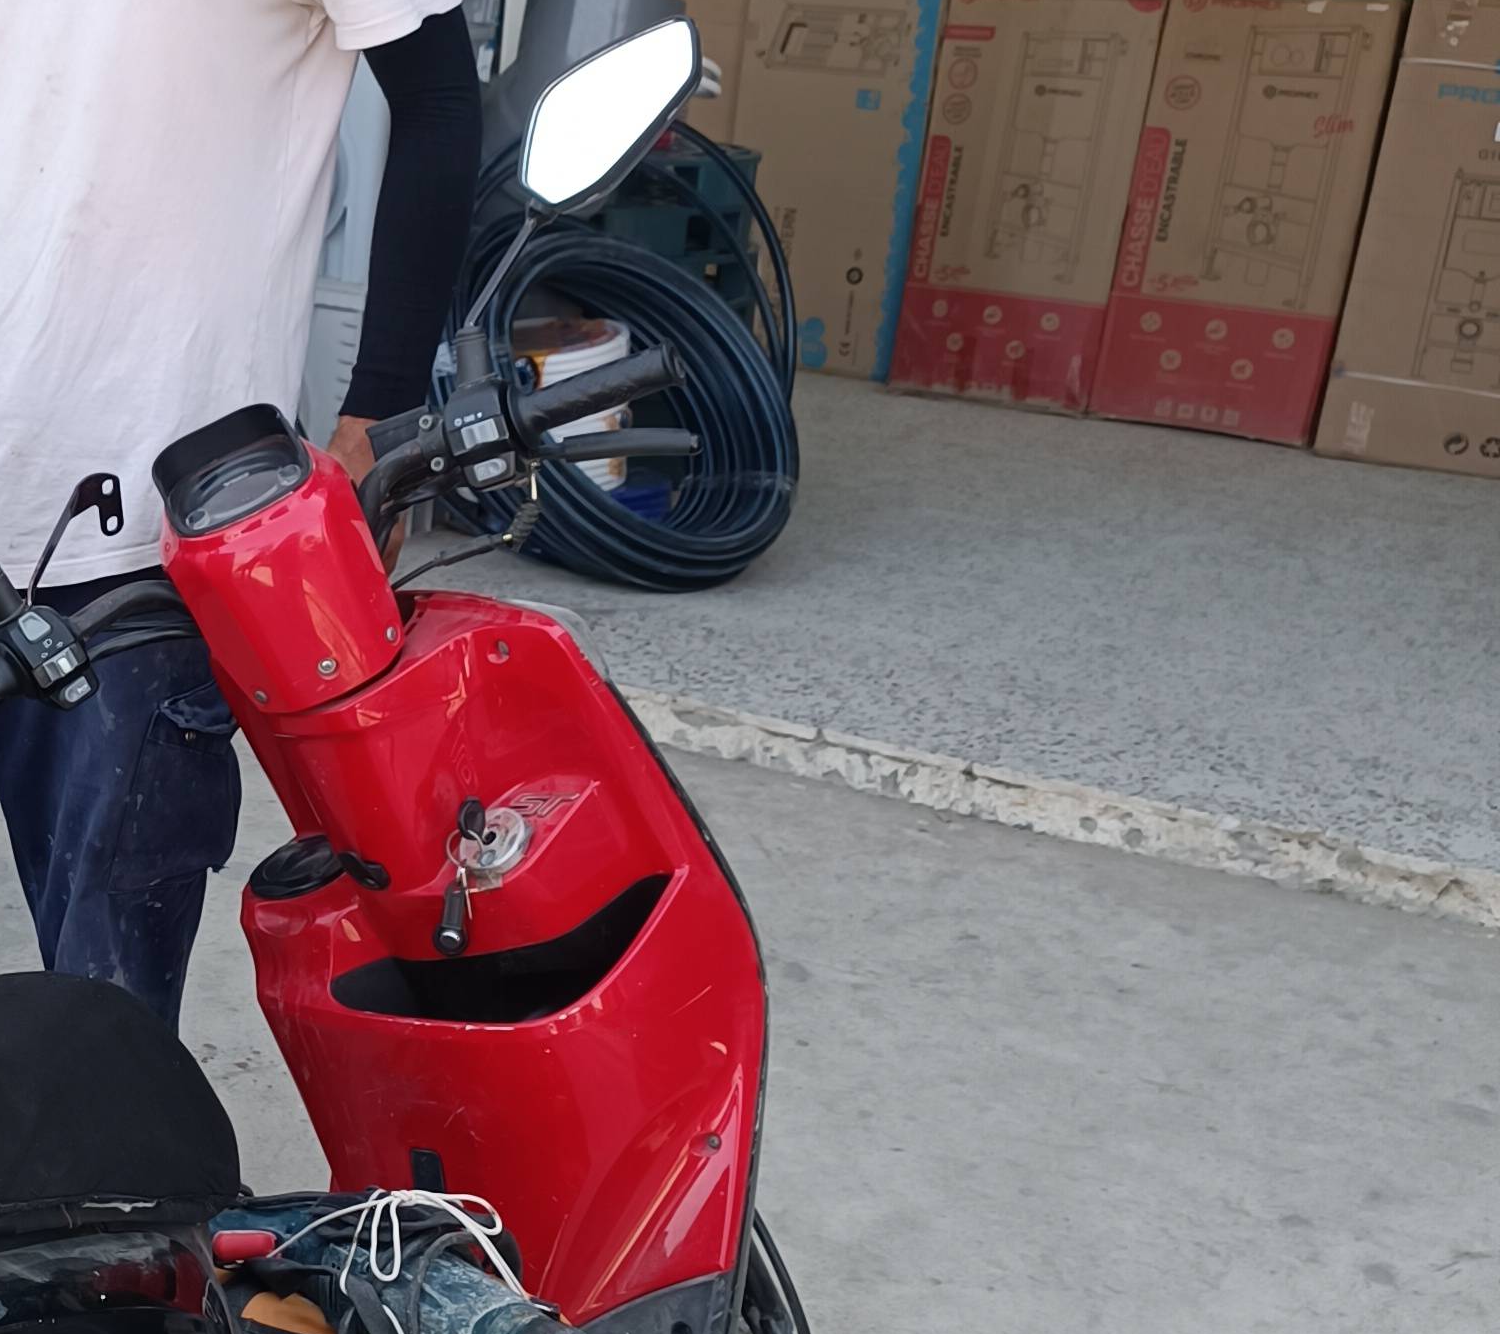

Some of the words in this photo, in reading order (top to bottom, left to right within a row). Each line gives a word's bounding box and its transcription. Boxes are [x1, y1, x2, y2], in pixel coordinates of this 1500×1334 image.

[1313, 115, 1355, 138] Slim
[940, 145, 964, 237] ENCASTRABLE
[1156, 139, 1187, 242] ENCASTRABLE
[914, 197, 939, 278] CHASSE
[1121, 196, 1155, 287] CHASSE
[510, 793, 580, 817] ST
